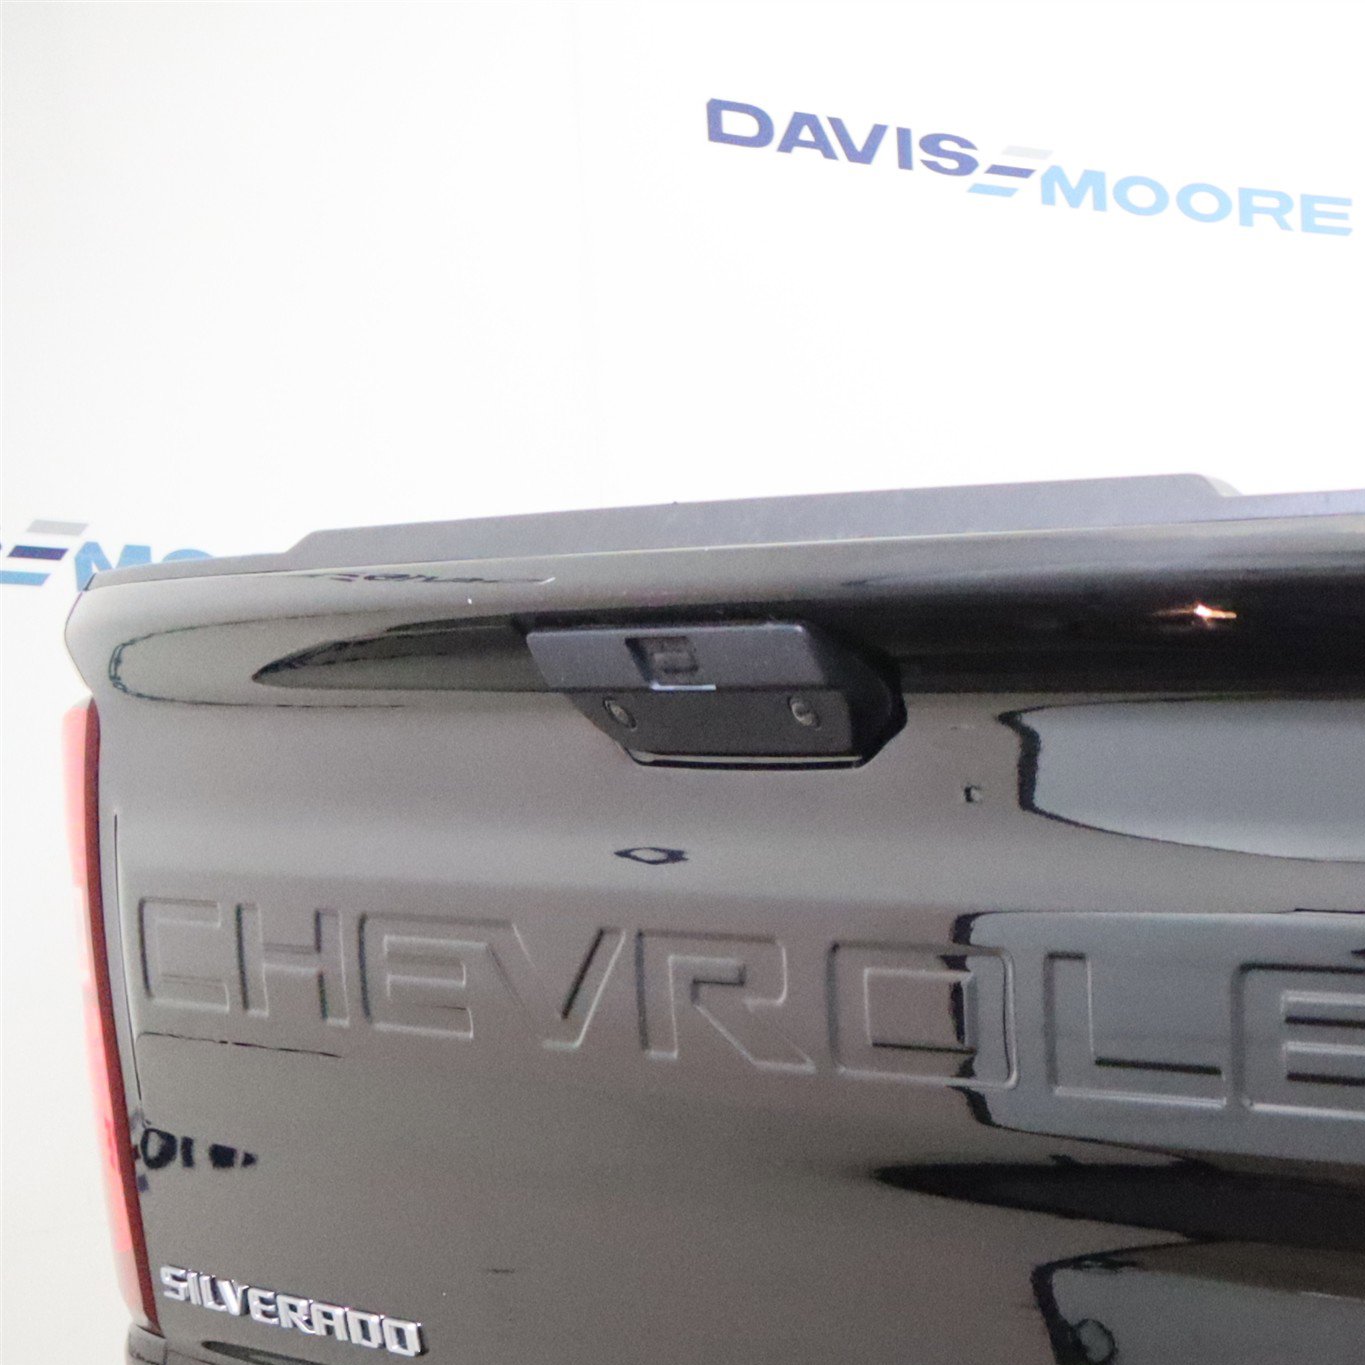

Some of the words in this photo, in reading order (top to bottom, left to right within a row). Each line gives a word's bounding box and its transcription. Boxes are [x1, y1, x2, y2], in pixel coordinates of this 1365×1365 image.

[706, 97, 979, 177] DAVIS
[1040, 164, 1354, 236] MOORE
[160, 1264, 424, 1357] SILVERADO
